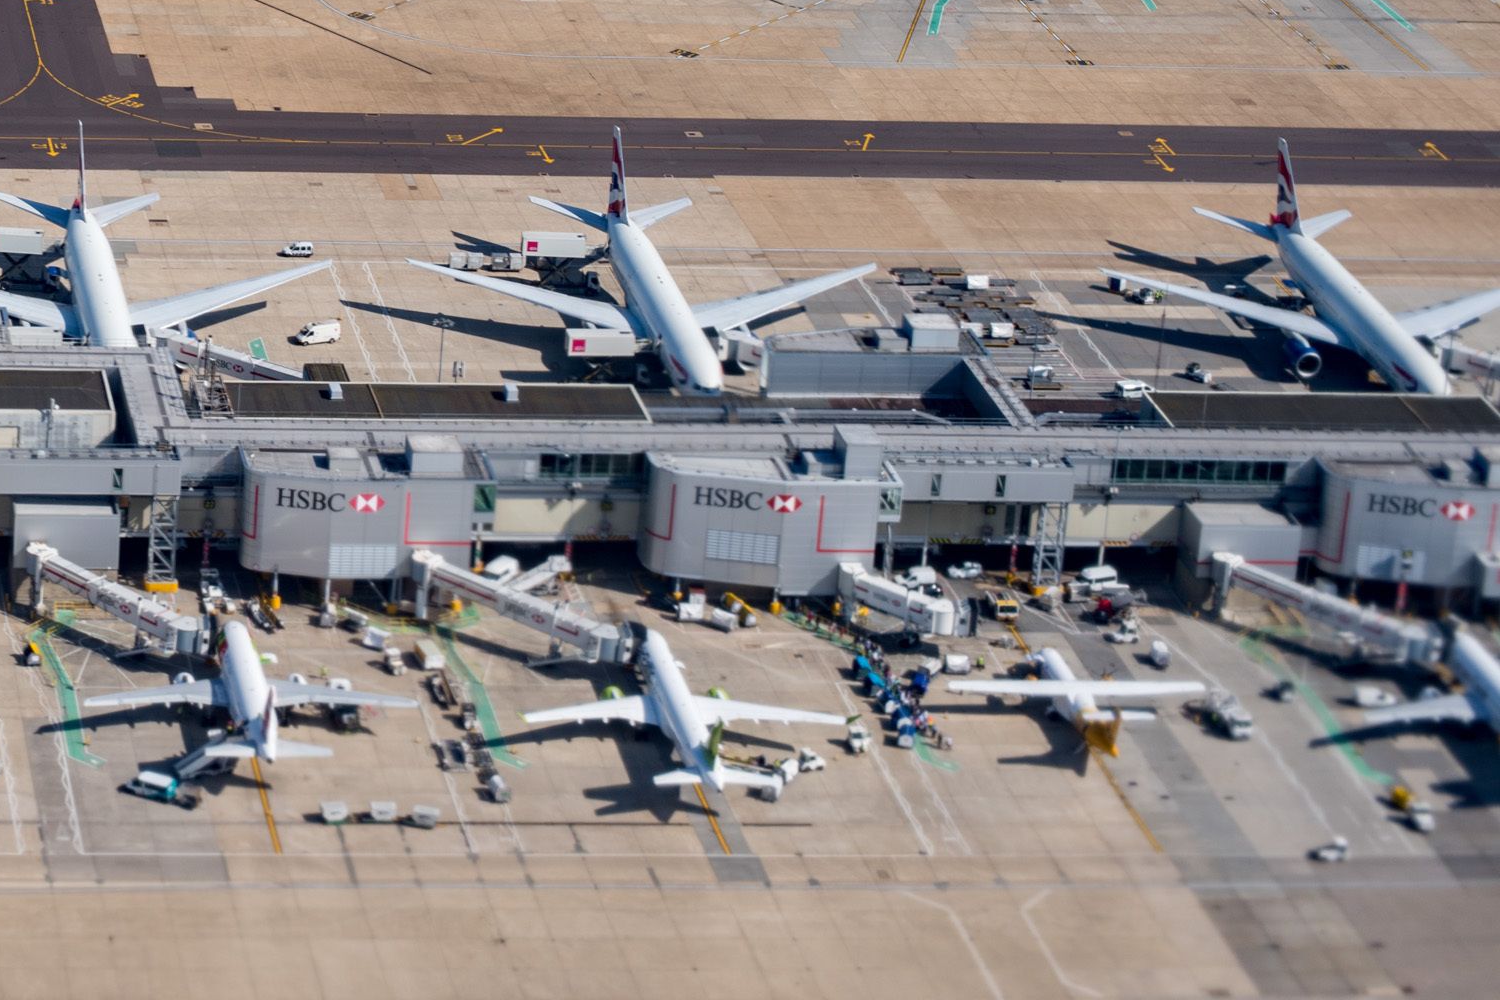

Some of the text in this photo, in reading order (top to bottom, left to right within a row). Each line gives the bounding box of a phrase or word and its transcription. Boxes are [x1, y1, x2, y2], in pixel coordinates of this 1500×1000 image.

[276, 487, 345, 513] HSBC
[694, 486, 763, 511] HSBC
[1367, 493, 1438, 519] HSBC
